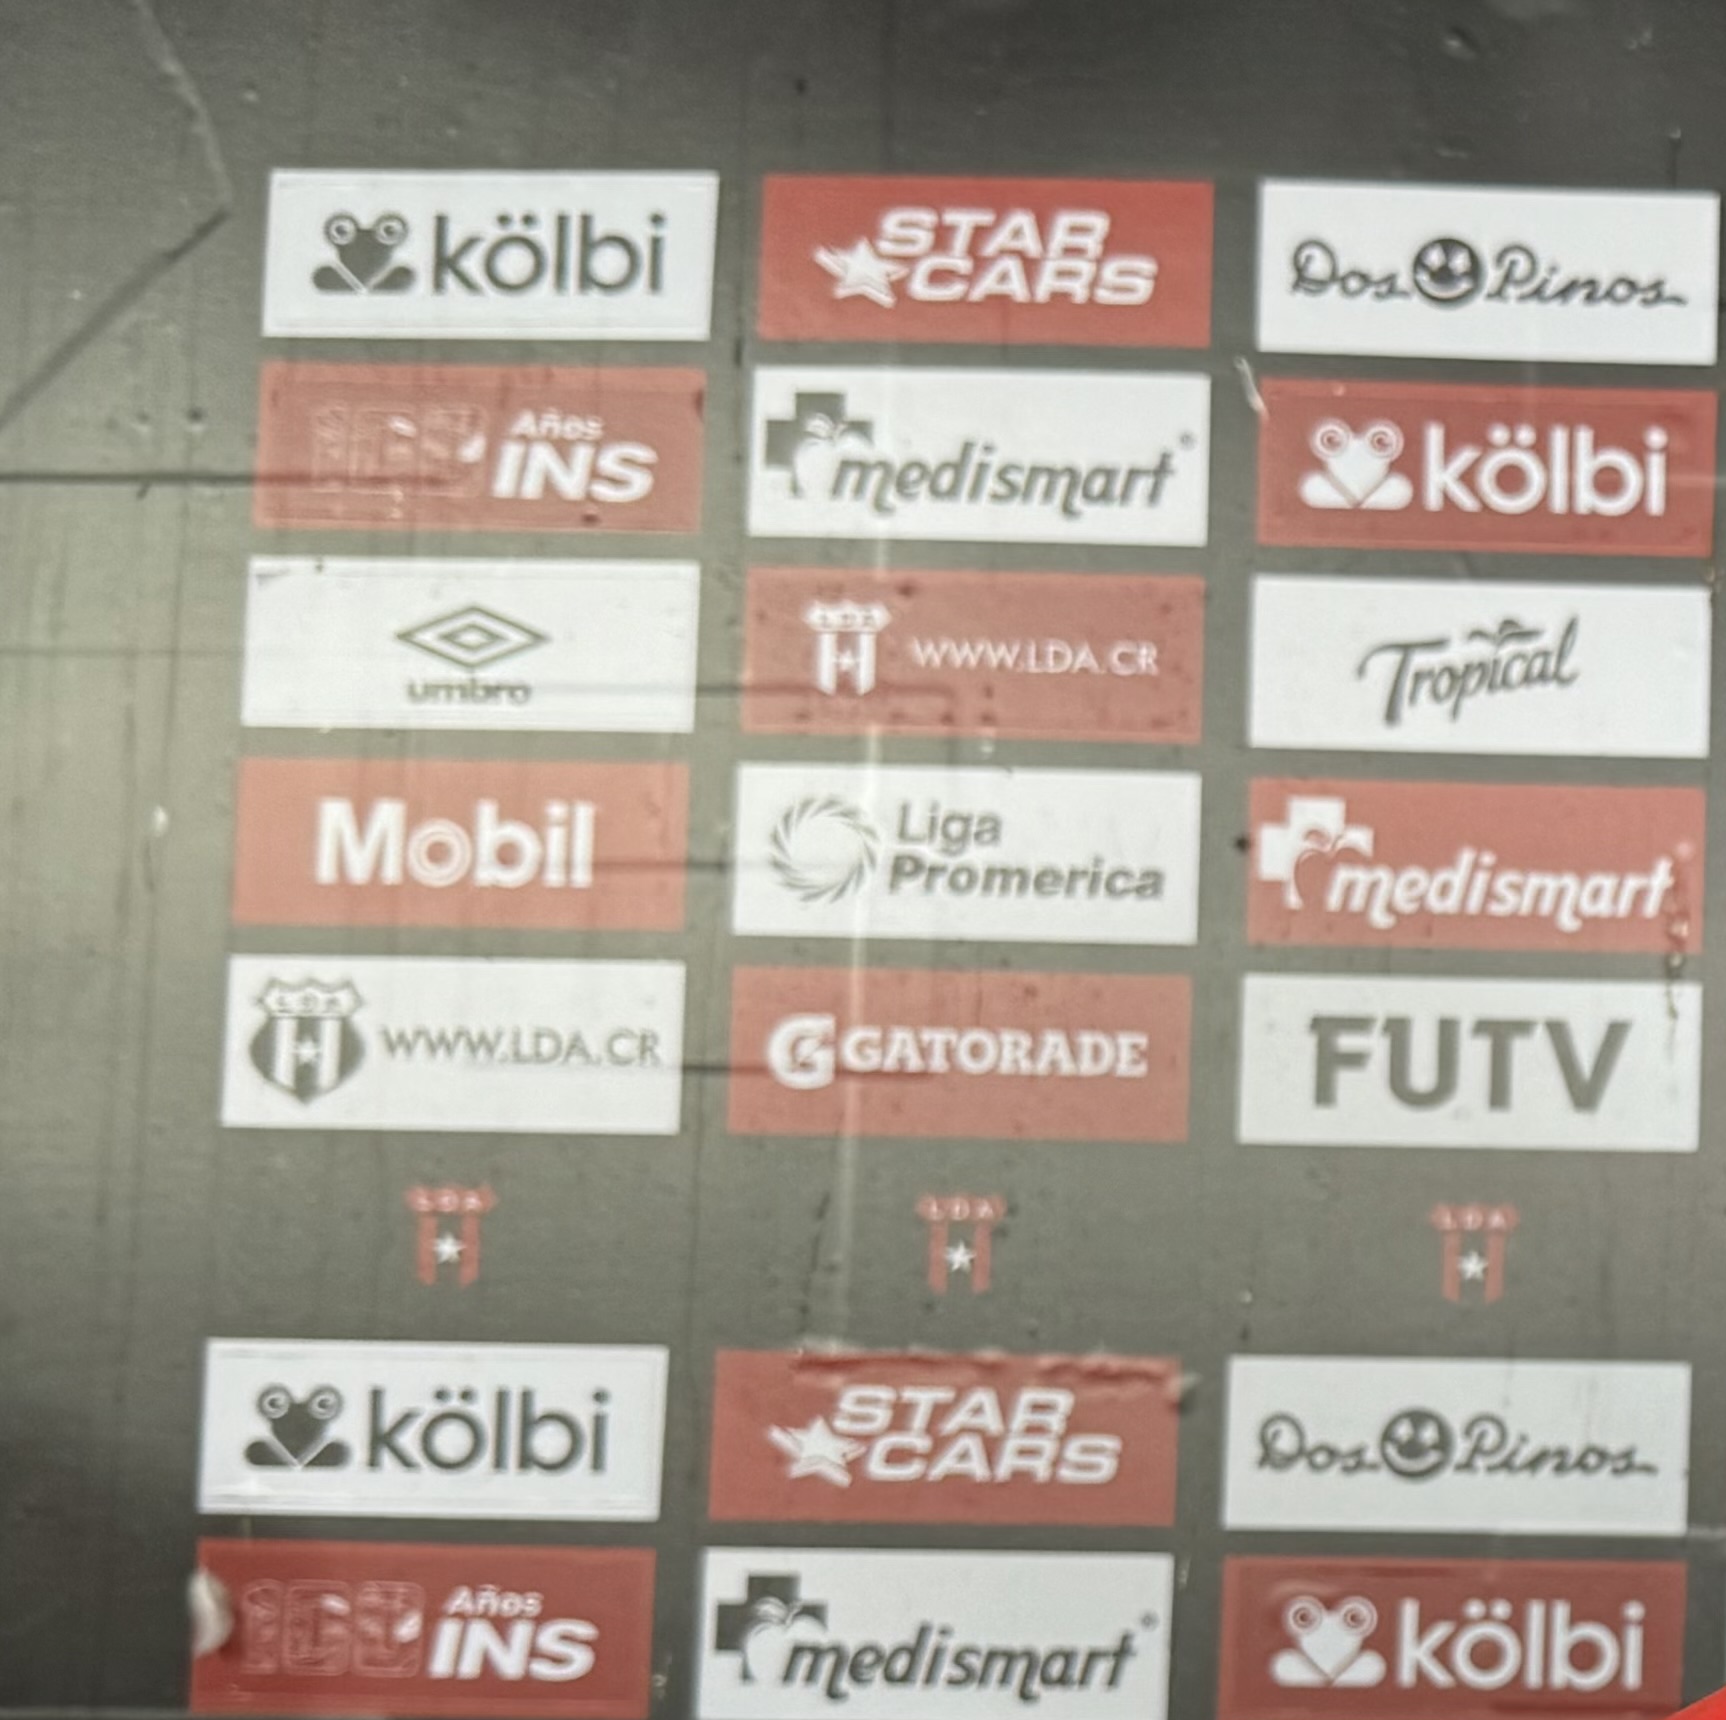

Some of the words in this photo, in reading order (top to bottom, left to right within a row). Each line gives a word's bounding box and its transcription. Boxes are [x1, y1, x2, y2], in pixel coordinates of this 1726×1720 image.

[432, 212, 666, 295] kölbi
[876, 209, 1109, 261] STAR
[903, 253, 1157, 304] CARS
[1290, 240, 1400, 295] Dos
[1485, 243, 1687, 307] Pinos
[493, 441, 656, 502] INS
[830, 440, 1175, 520] medismart
[1424, 423, 1667, 515] kölbi
[907, 637, 1157, 675] WWW.LDA.CR
[1358, 618, 1578, 729] Tropical
[407, 677, 533, 705] umbro
[316, 798, 595, 887] Mobil
[897, 803, 1002, 857] Liga
[889, 853, 1165, 900] Promerica
[1327, 848, 1673, 932] medismart
[379, 1026, 660, 1068] WWW.LDA.CR
[840, 1024, 1147, 1076] GATORADE
[1308, 1014, 1631, 1113] FUTV
[366, 1387, 609, 1474] kölbi
[832, 1385, 1074, 1441] STAR
[865, 1429, 1121, 1482] CARS
[1258, 1413, 1379, 1473] Dos
[1454, 1413, 1658, 1477] Pinos
[445, 1585, 541, 1617] Años
[429, 1618, 597, 1680] INS
[781, 1623, 1136, 1704] medismart
[1398, 1599, 1644, 1689] kölbi
